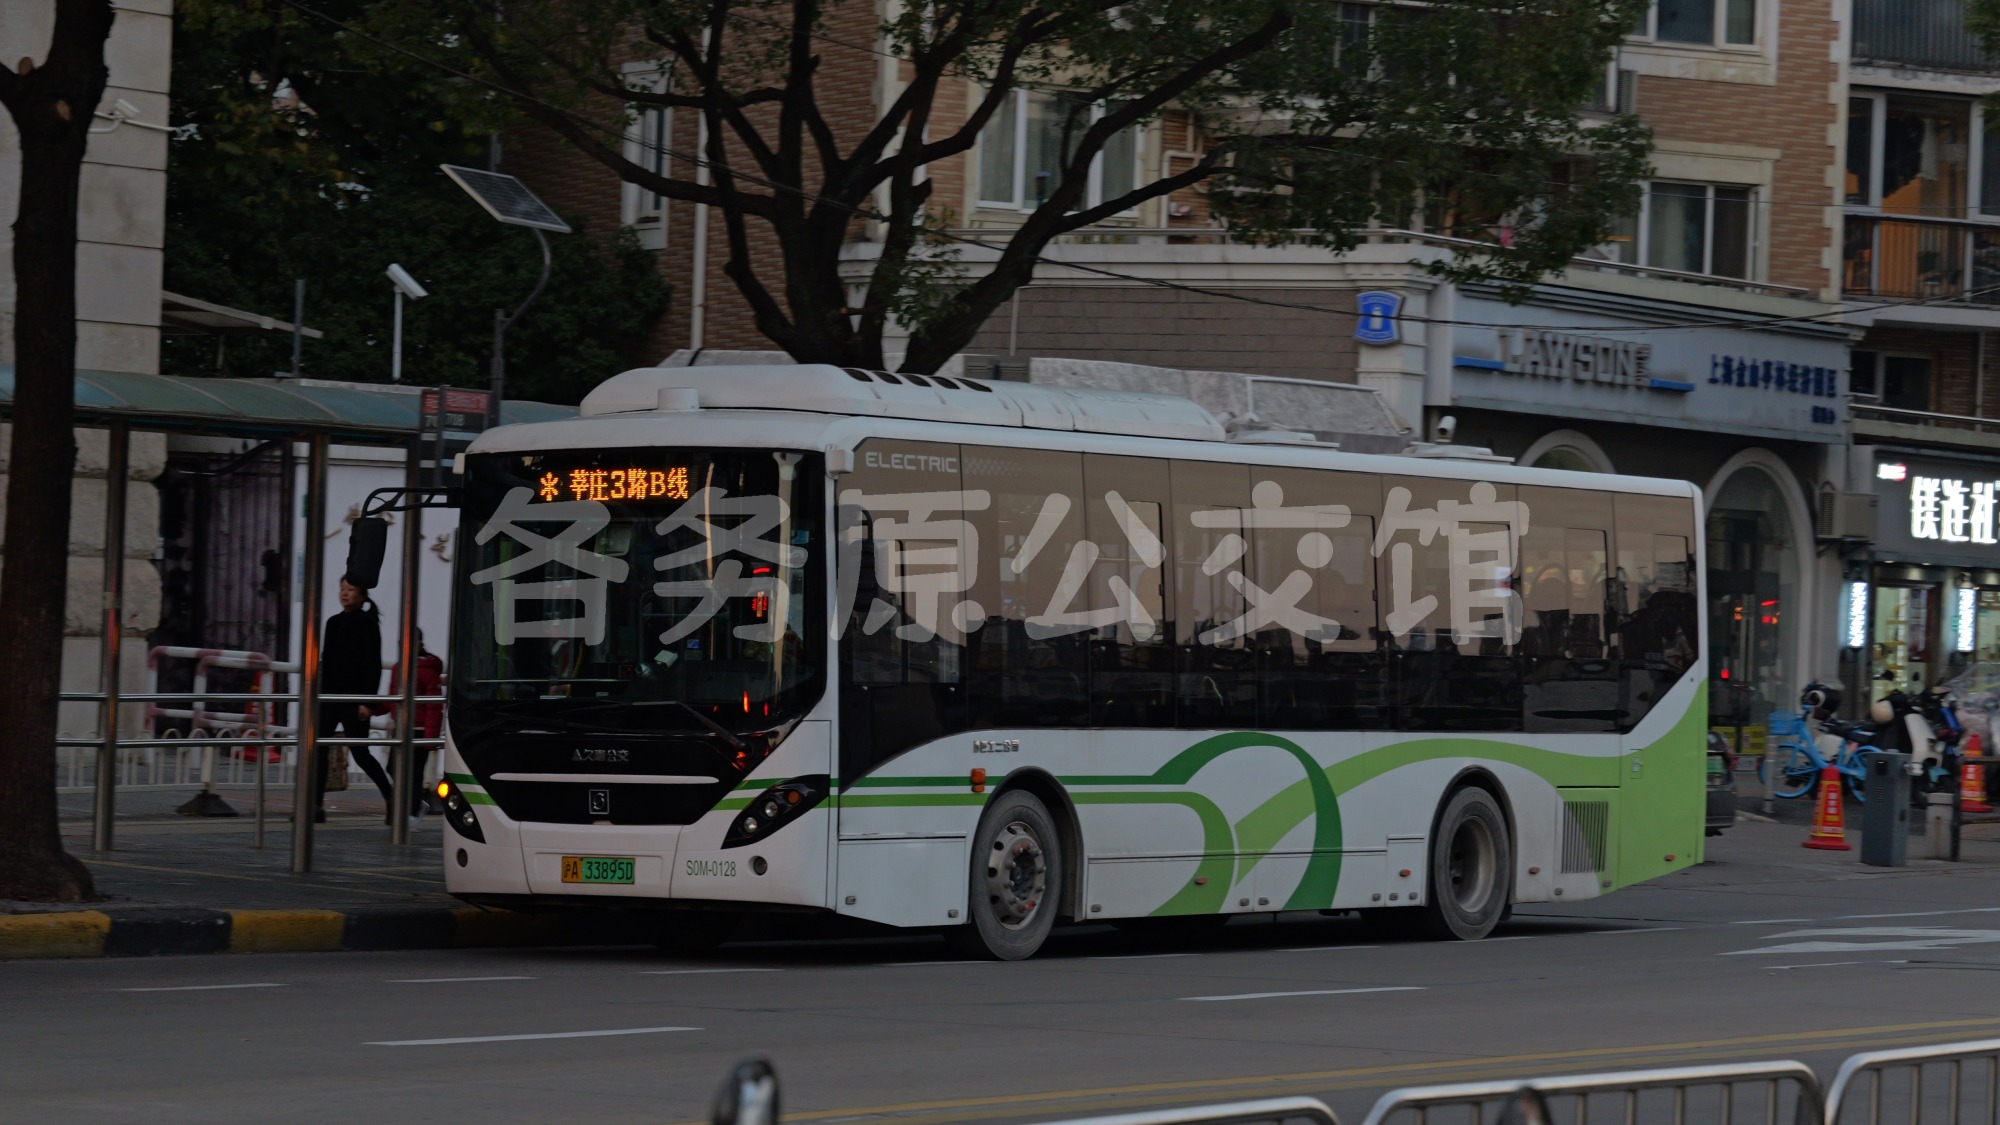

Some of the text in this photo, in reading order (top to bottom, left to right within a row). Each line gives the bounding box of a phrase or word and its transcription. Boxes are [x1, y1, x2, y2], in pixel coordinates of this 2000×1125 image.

[1497, 328, 1635, 385] LAWSON
[865, 451, 958, 474] ELECTRIC
[569, 467, 689, 501] 莘庄3路B线
